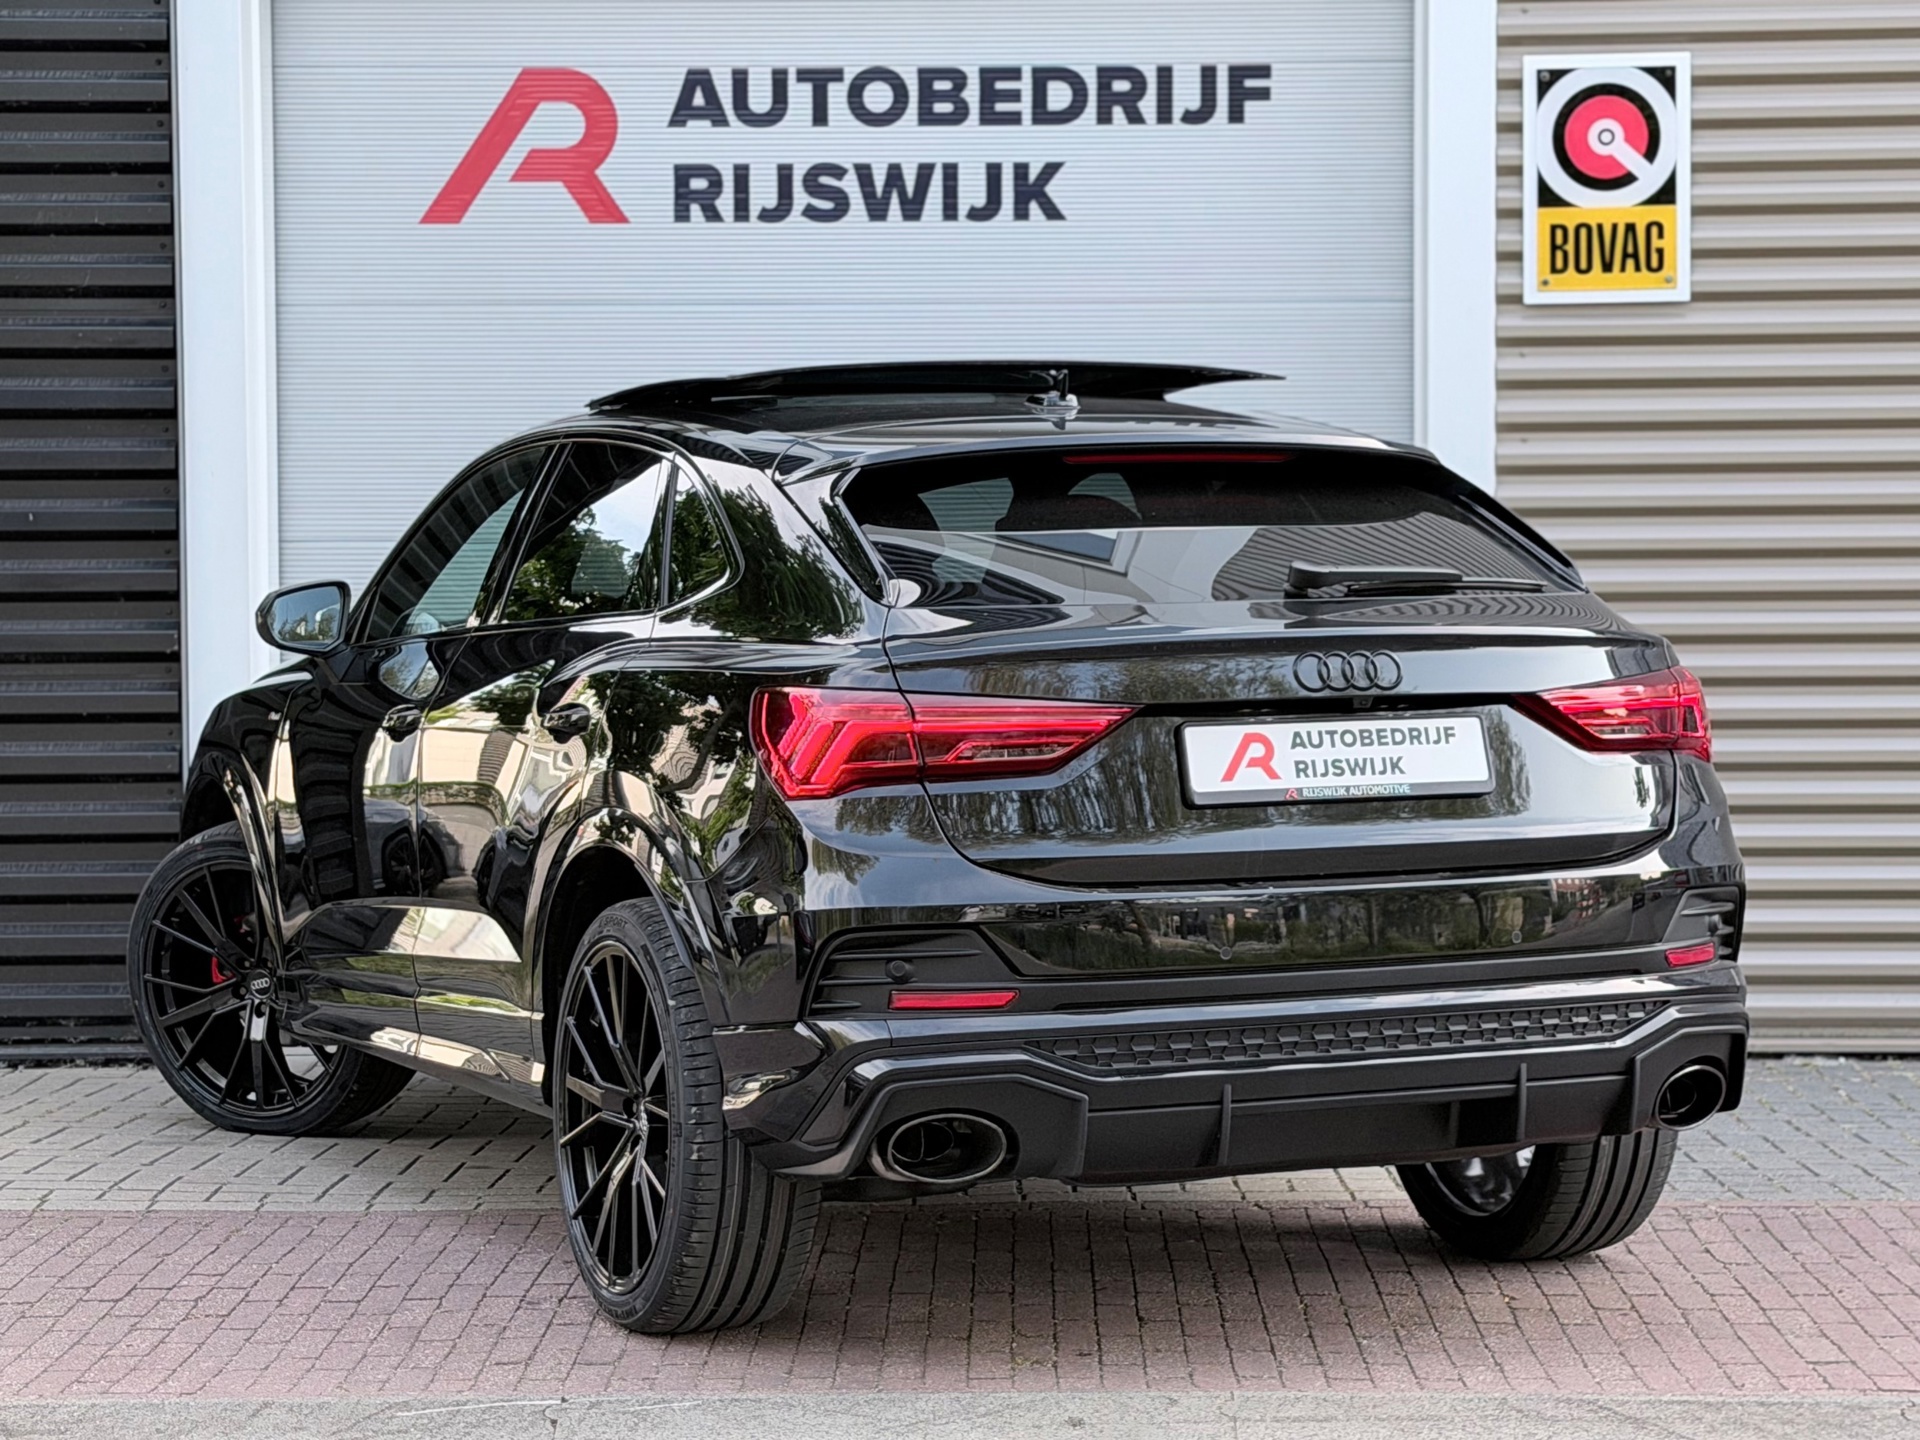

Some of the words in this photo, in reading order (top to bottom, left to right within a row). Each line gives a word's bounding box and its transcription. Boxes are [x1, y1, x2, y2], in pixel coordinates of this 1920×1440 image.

[668, 64, 1271, 127] AUTOBEDRIJF
[674, 162, 1065, 222] RIJSWIJK
[1549, 221, 1665, 275] BOVAG
[1290, 726, 1456, 750] AUTOBEDRIJF
[1294, 756, 1406, 779] RIJSWIJK
[1302, 786, 1348, 797] RIJSWIJK
[1348, 784, 1411, 796] AUTOMOTIVE
